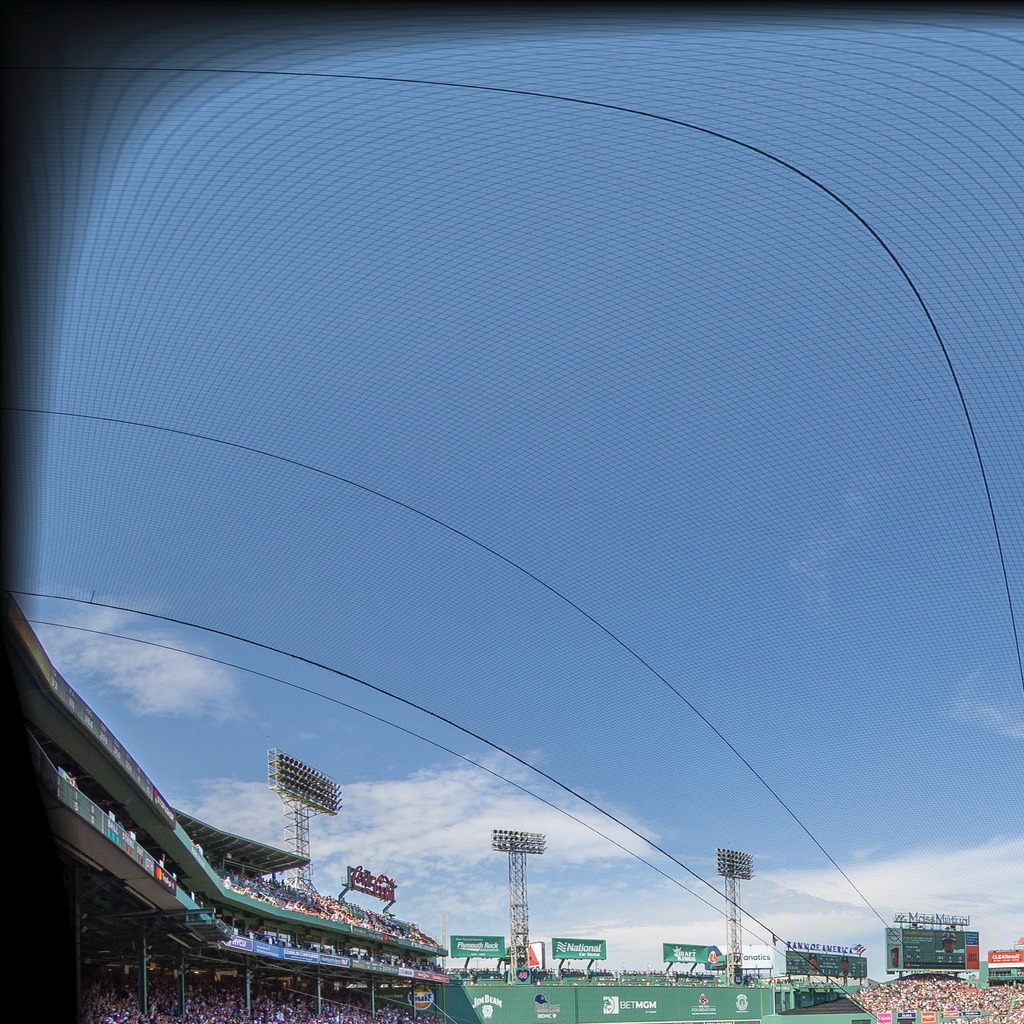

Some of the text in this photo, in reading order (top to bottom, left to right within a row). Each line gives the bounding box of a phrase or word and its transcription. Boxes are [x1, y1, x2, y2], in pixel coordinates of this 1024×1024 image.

[457, 941, 483, 949] Plymouth
[566, 943, 602, 952] National
[821, 944, 853, 954] AMERICA
[485, 994, 503, 1008] BEAM
[620, 1000, 657, 1009] BETMGM
